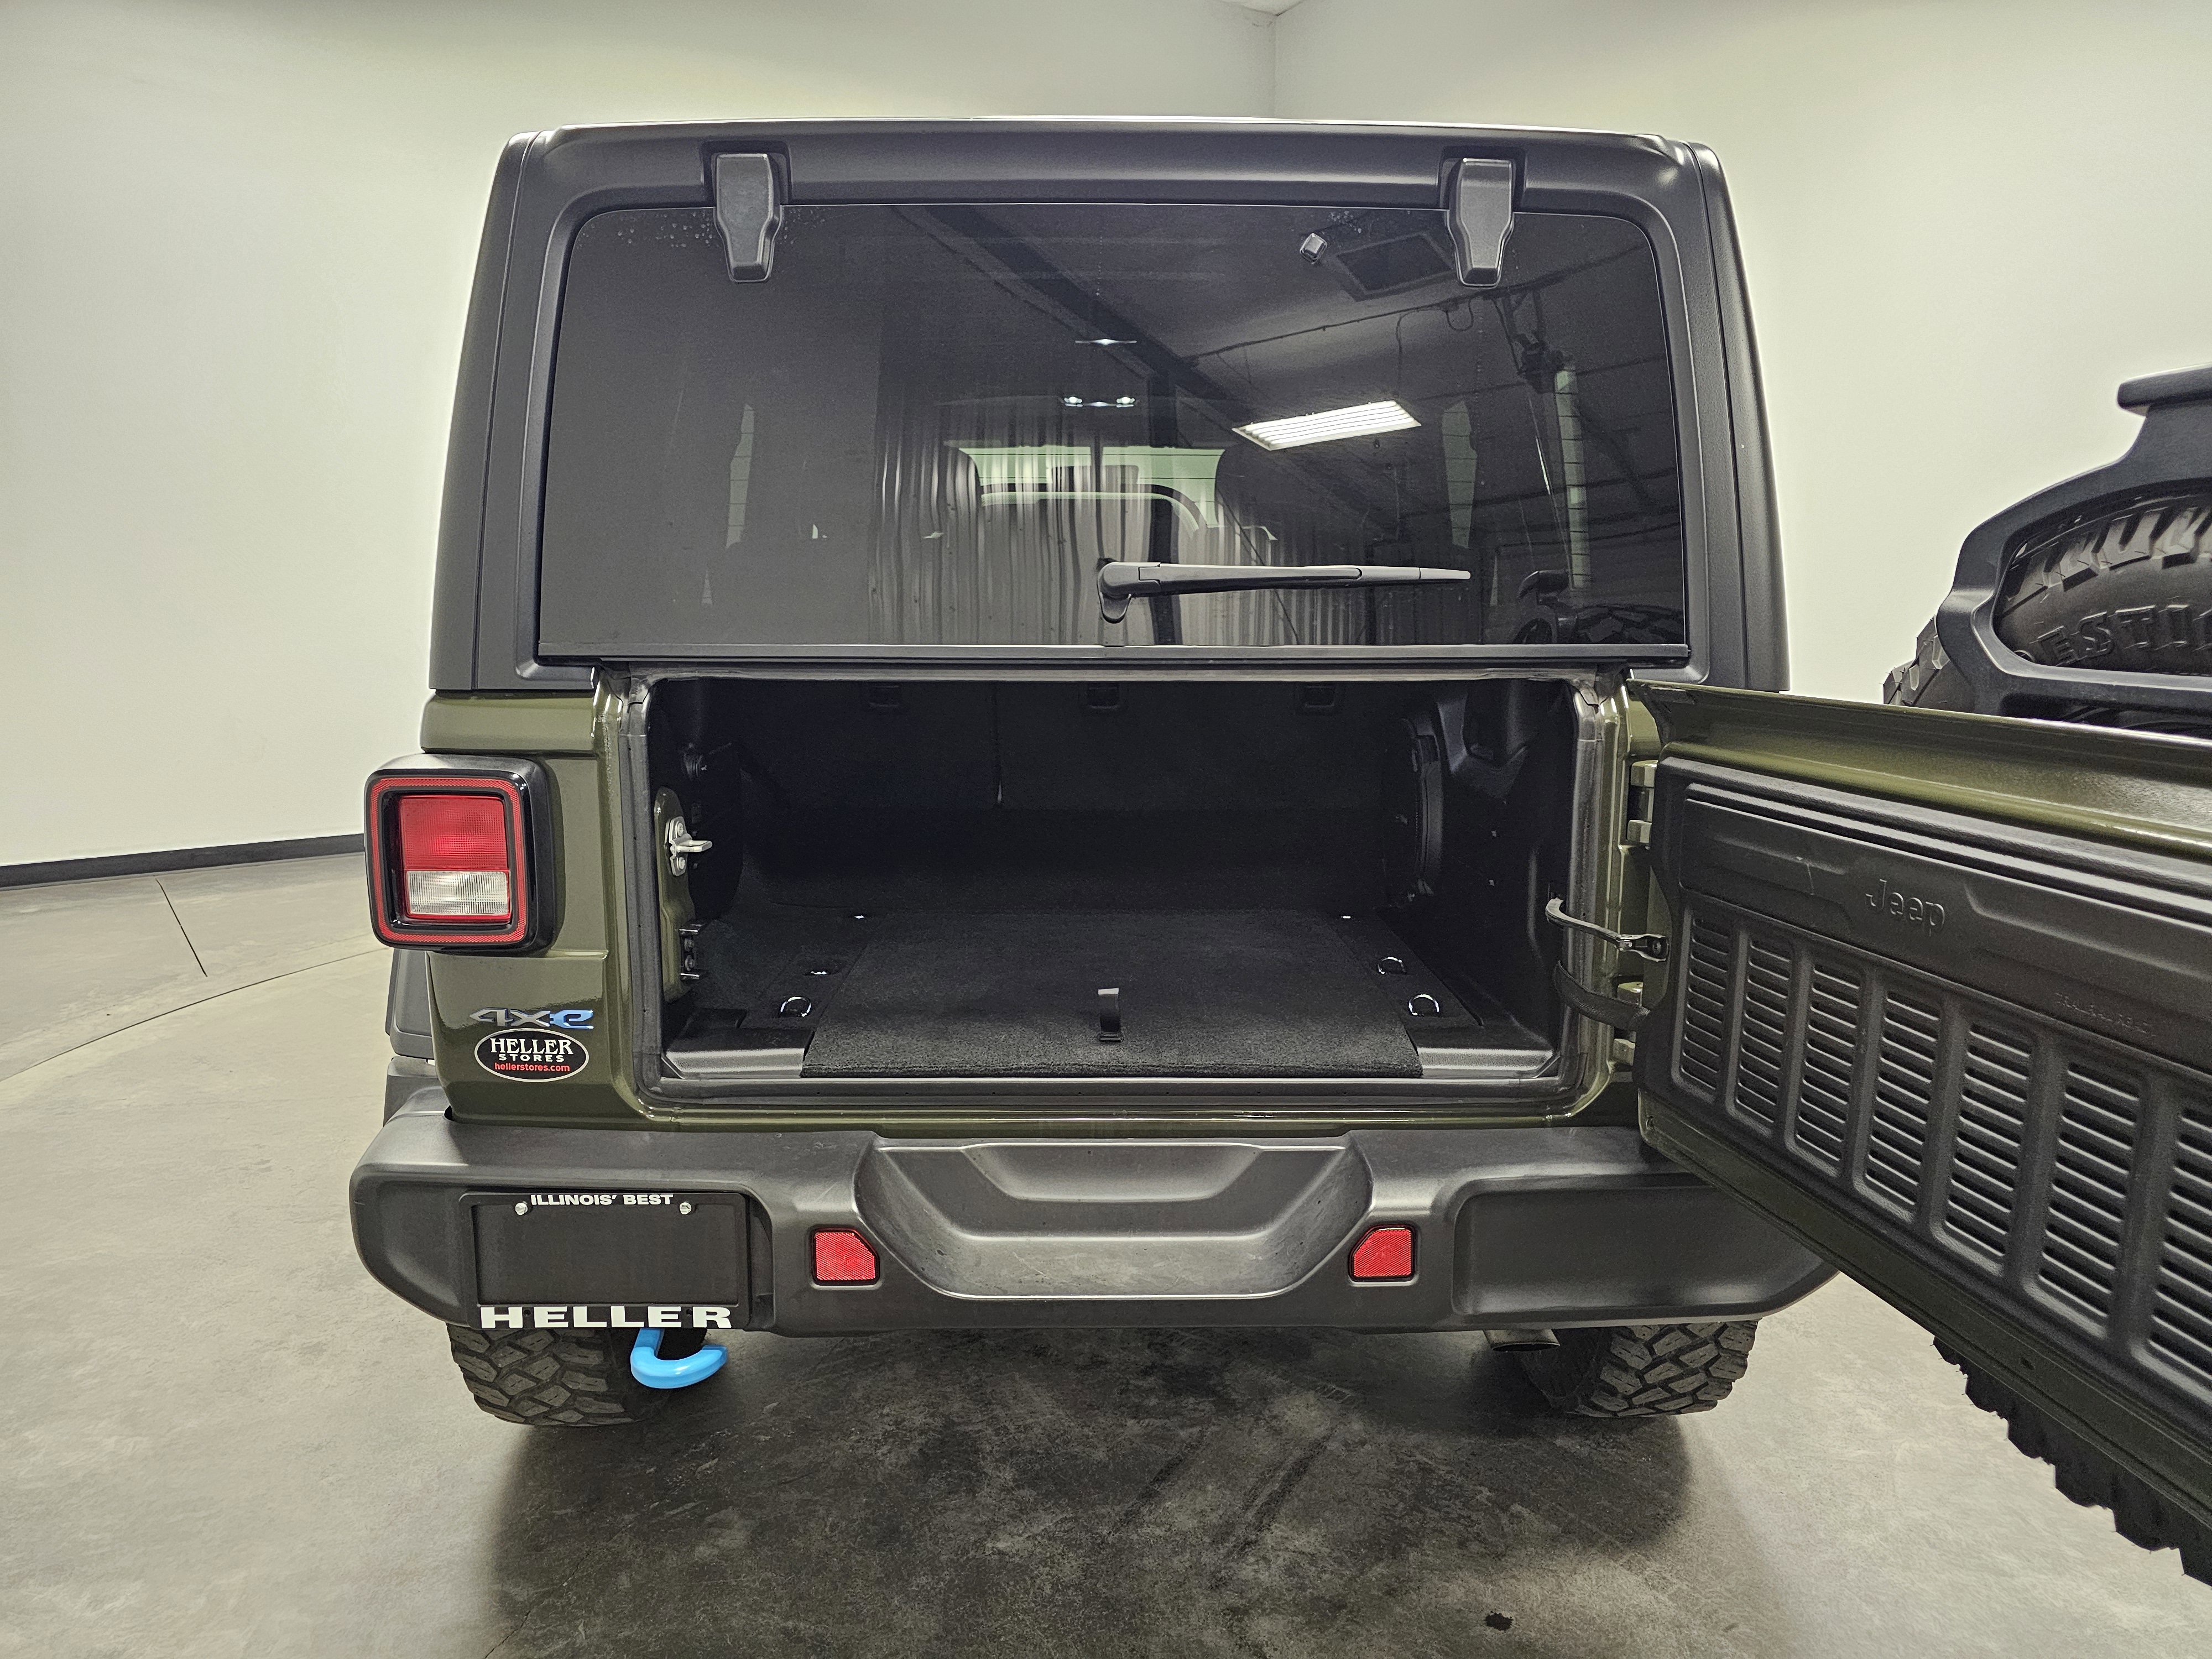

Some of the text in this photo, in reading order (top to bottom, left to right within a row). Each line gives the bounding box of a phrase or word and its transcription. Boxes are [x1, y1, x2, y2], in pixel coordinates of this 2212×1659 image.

[1865, 879, 1945, 937] Jeep
[490, 1037, 573, 1055] HELLER
[494, 1062, 570, 1072] hellerstores.com
[530, 1194, 674, 1205] ILLINOIS' BEST
[480, 1306, 732, 1328] HELLER
